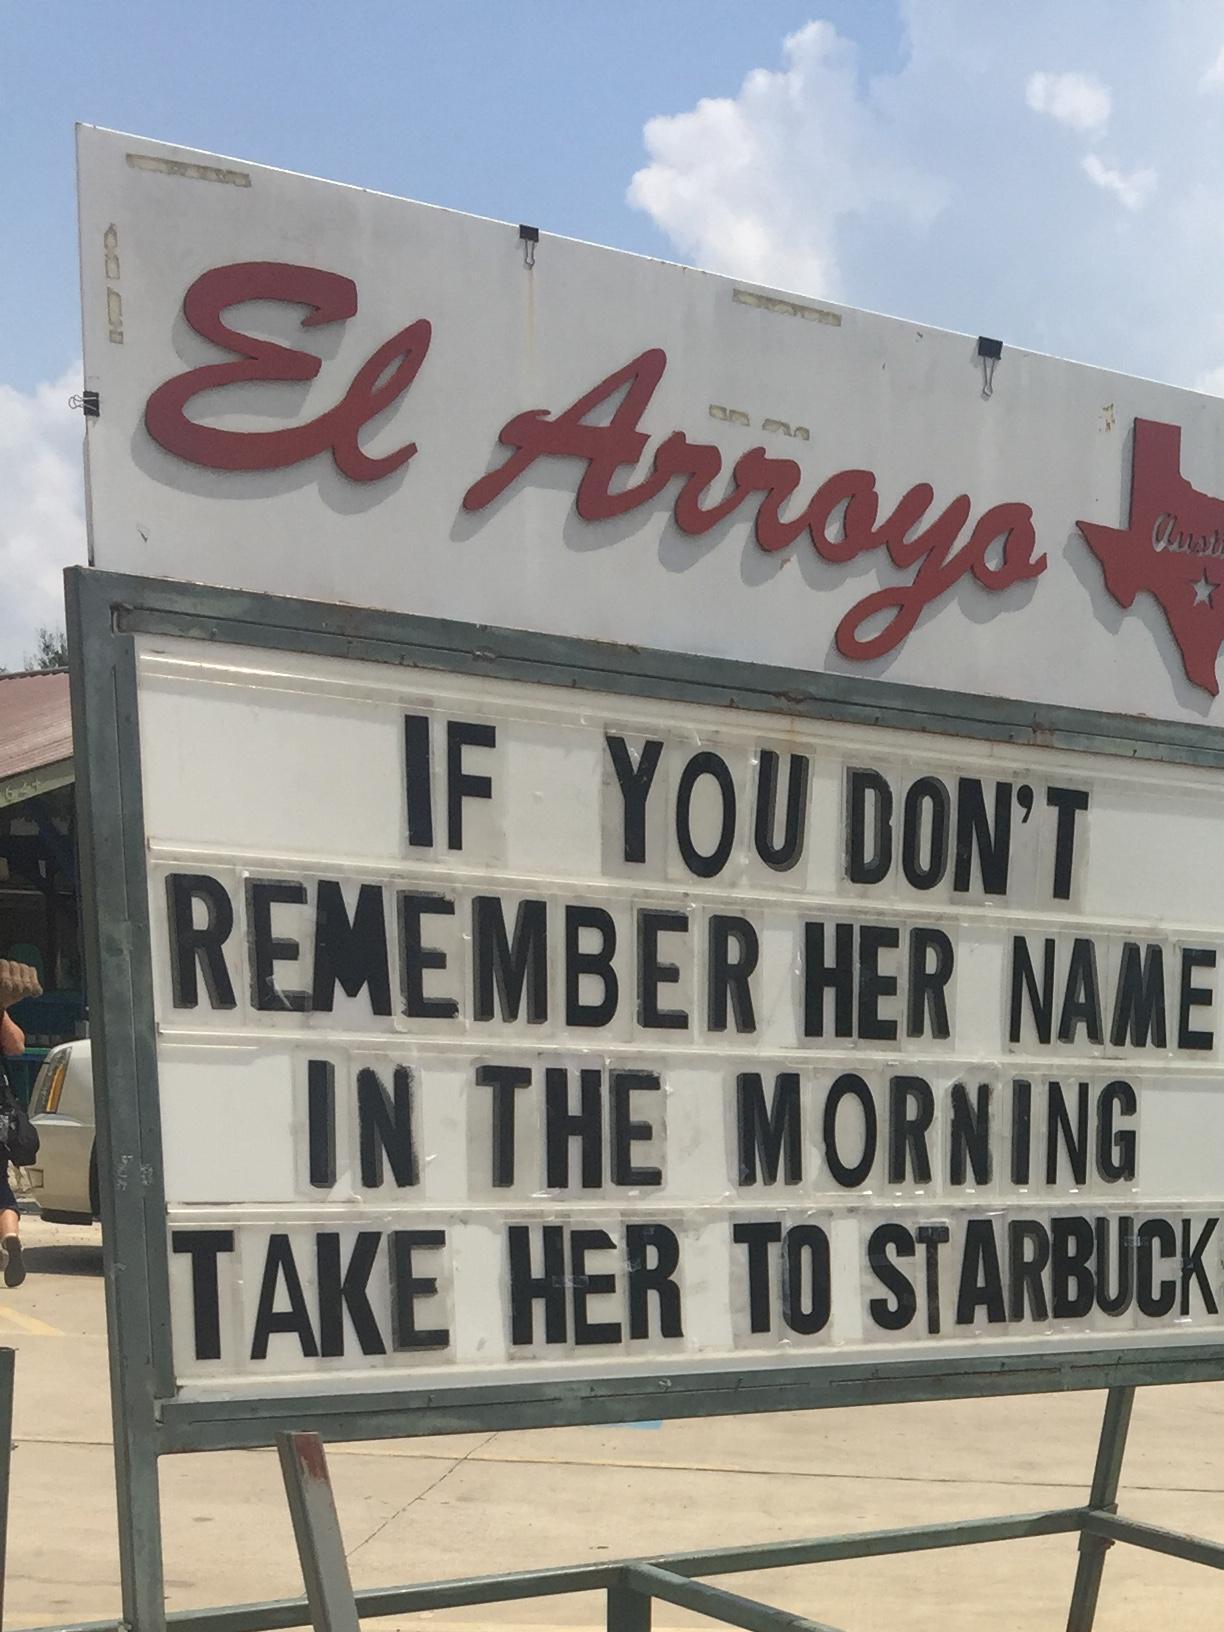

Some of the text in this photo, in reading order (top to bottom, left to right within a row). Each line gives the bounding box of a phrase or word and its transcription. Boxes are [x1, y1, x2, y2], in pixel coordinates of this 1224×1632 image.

[144, 260, 1047, 661] El Arroyo
[404, 714, 1089, 900] IF YOU DON'T
[165, 873, 1216, 1050] REMEMBER HER NAME
[308, 1060, 1136, 1189] IN THE MORNING
[171, 1230, 449, 1361] TAKE
[508, 1224, 684, 1346] HER
[733, 1222, 831, 1335] TO
